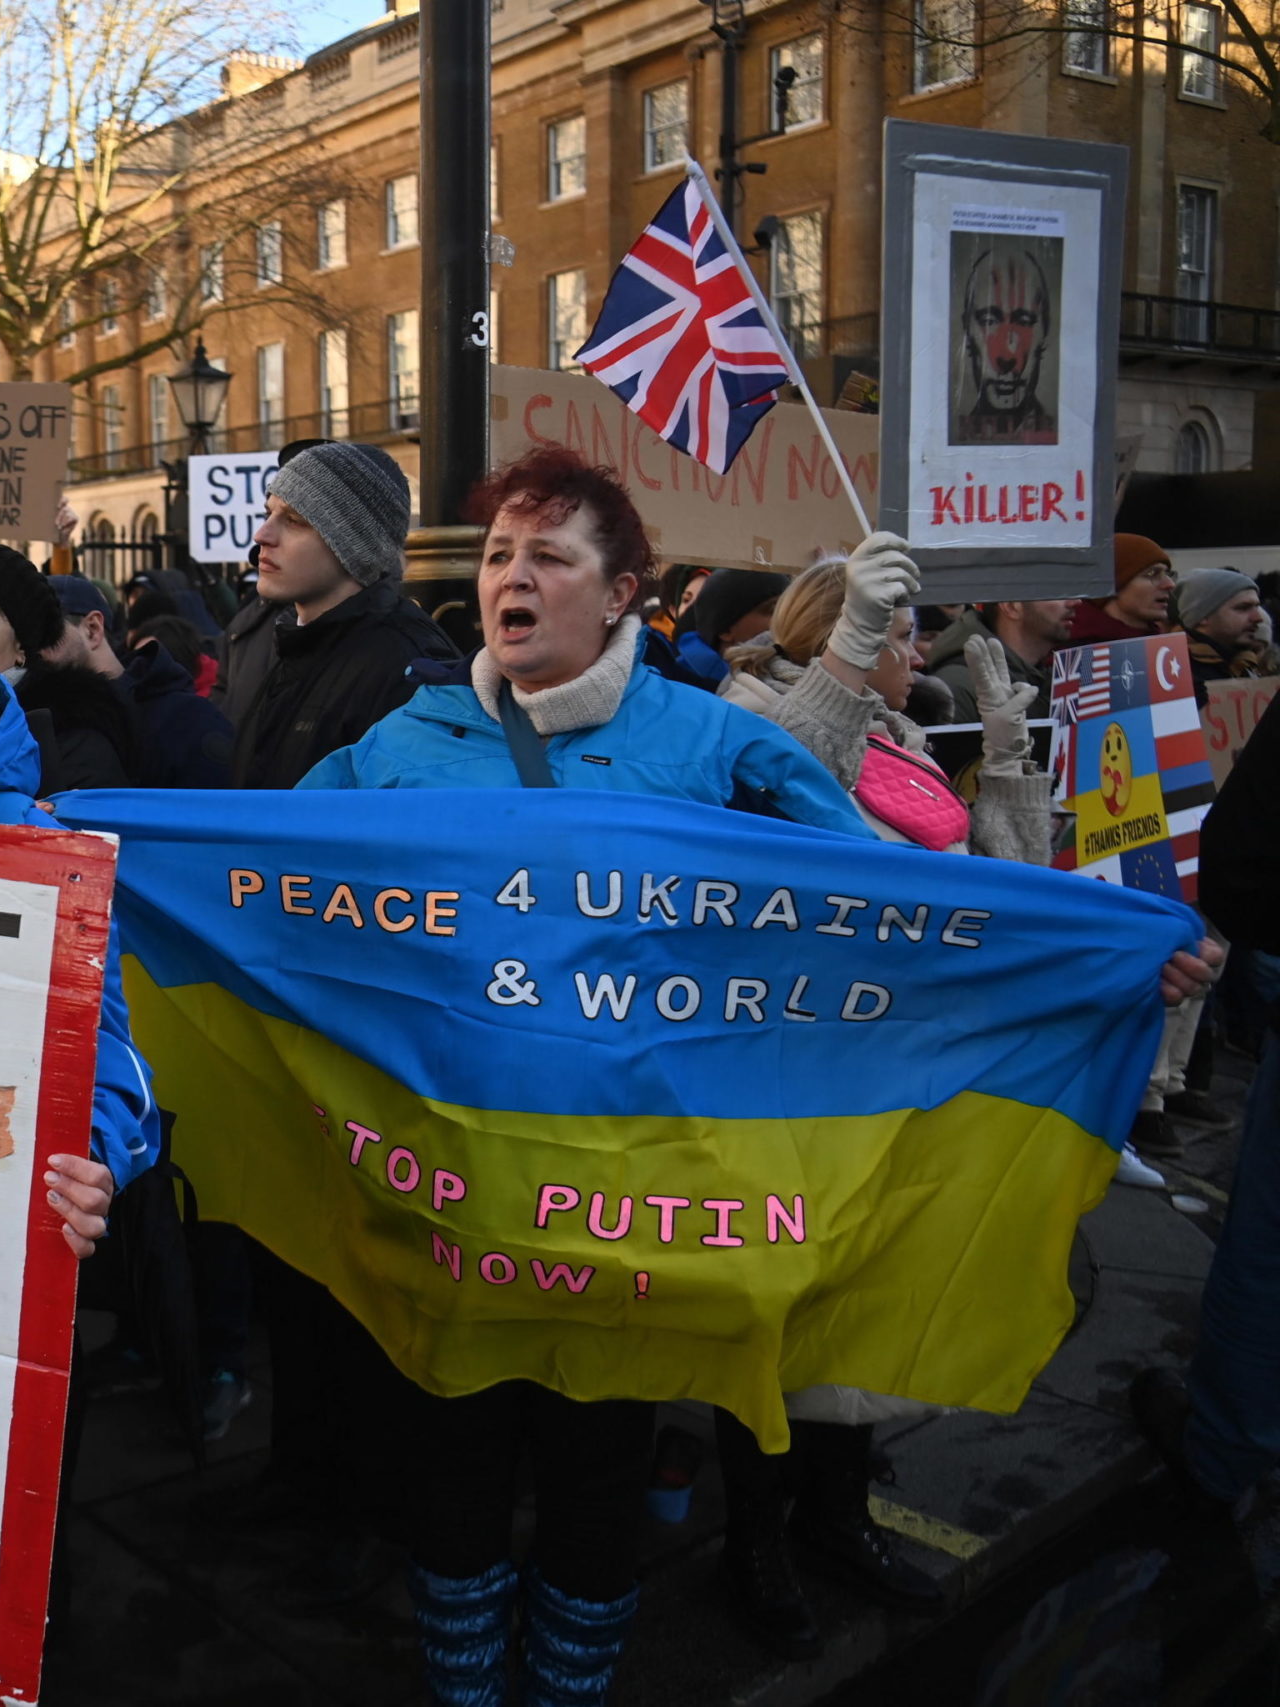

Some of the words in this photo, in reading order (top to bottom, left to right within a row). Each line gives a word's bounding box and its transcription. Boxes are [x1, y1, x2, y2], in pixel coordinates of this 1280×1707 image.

[471, 311, 489, 347] 3
[19, 404, 67, 440] OFF
[1085, 824, 1121, 857] #THANKS
[1121, 813, 1162, 846] FRIENDS
[227, 868, 460, 937] PEACE
[496, 867, 538, 914] 4
[574, 869, 993, 949] UKRAINE
[484, 957, 542, 1008] &
[573, 971, 893, 1023] WORLD
[312, 1103, 468, 1212] TOP
[534, 1183, 807, 1247] PUTIN
[431, 1230, 596, 1294] NOW
